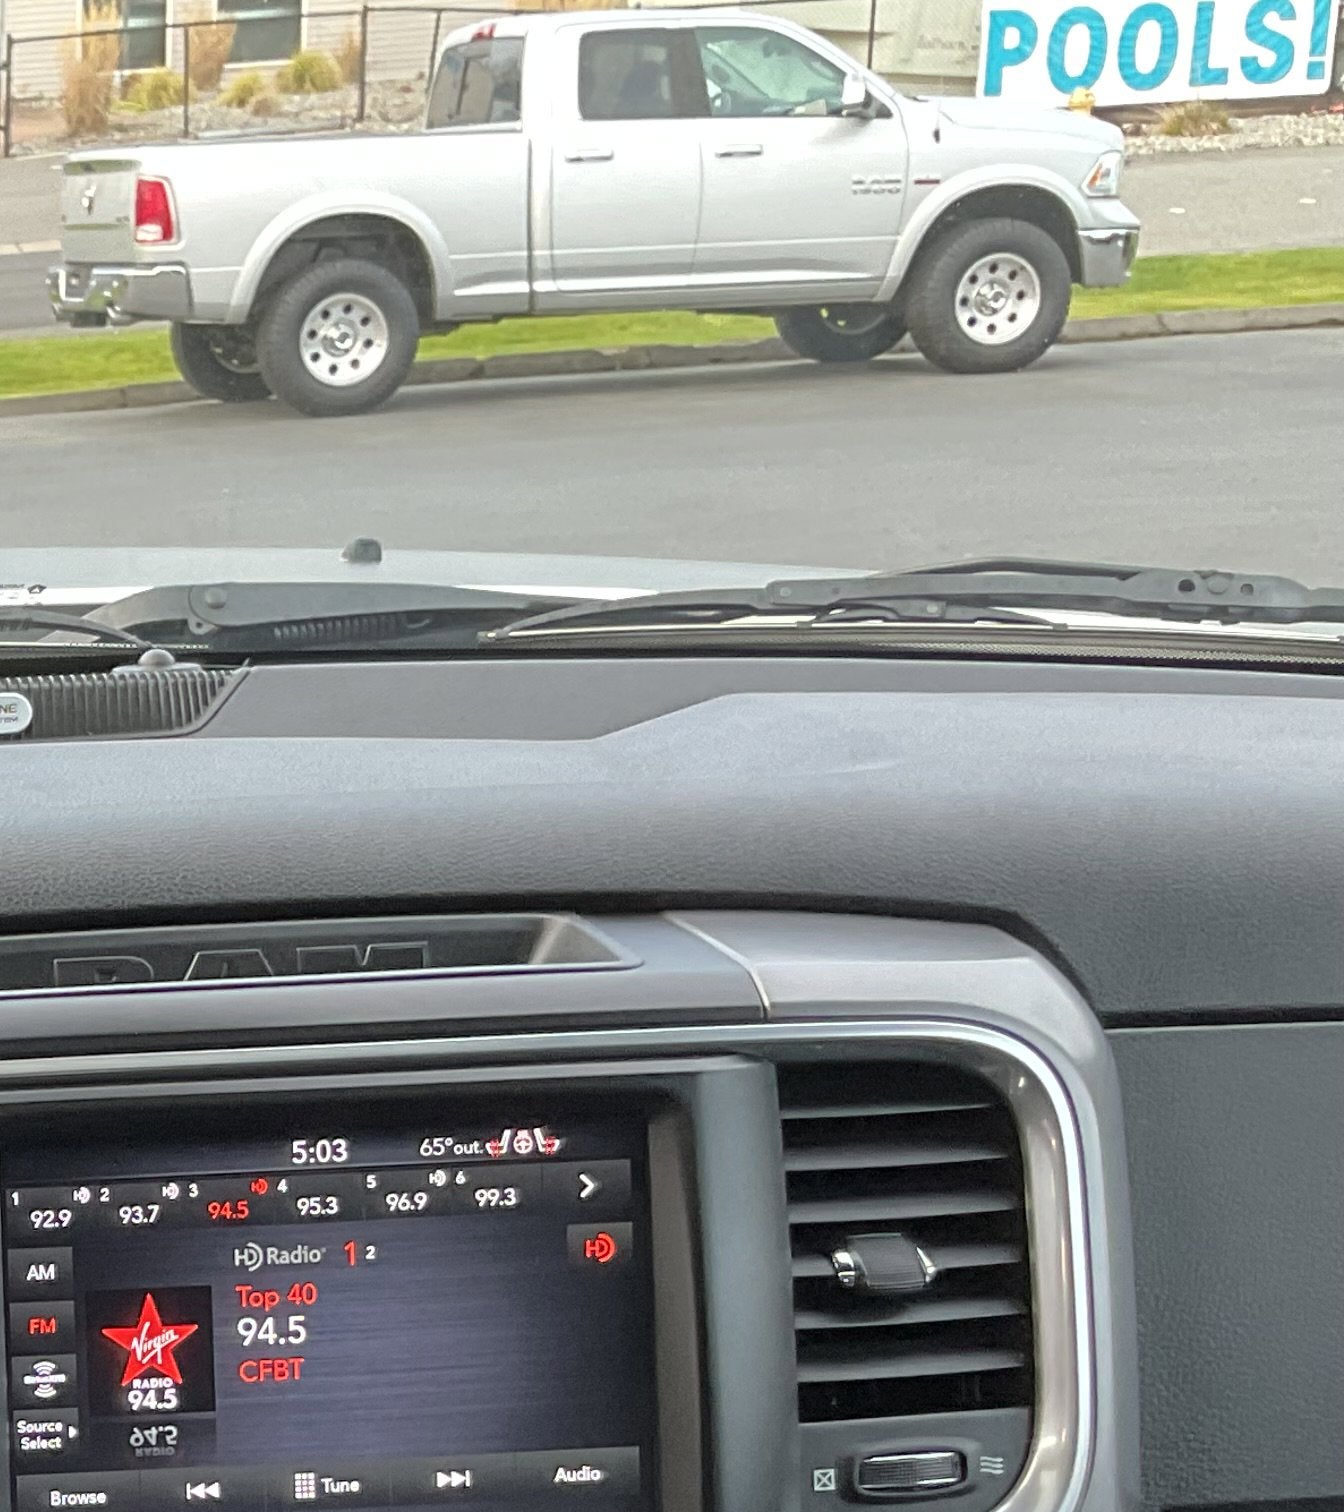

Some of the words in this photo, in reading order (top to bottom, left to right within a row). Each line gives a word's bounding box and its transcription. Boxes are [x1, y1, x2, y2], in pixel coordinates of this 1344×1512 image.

[984, 0, 1332, 97] POOLS!
[291, 1138, 348, 1164] 5:03
[276, 1178, 288, 1193] 4
[366, 1174, 377, 1189] 5
[455, 1170, 466, 1185] 6
[12, 1190, 20, 1206] 1
[99, 1188, 110, 1202] 2
[189, 1183, 199, 1198] 3
[474, 1187, 517, 1207] 99.3
[208, 1200, 250, 1219] 94.5
[296, 1196, 339, 1216] 95.3
[385, 1191, 428, 1211] 96.9
[30, 1209, 72, 1228] 92.9
[119, 1204, 160, 1224] 93.7
[267, 1244, 322, 1265] Radio
[344, 1240, 356, 1266] 1
[365, 1245, 376, 1260] 2
[26, 1263, 55, 1281] AM
[235, 1284, 280, 1312] Top
[287, 1283, 317, 1306] 40
[28, 1318, 57, 1335] FM
[236, 1315, 307, 1346] 94.5
[131, 1321, 180, 1365] Virgin
[239, 1357, 304, 1383] CFBT
[132, 1377, 174, 1389] RADIO
[127, 1387, 178, 1411] 94.5
[16, 1418, 63, 1434] Source
[20, 1436, 62, 1450] Select
[554, 1466, 602, 1483] Audio
[321, 1477, 360, 1493] Tune
[49, 1490, 107, 1507] Browse
